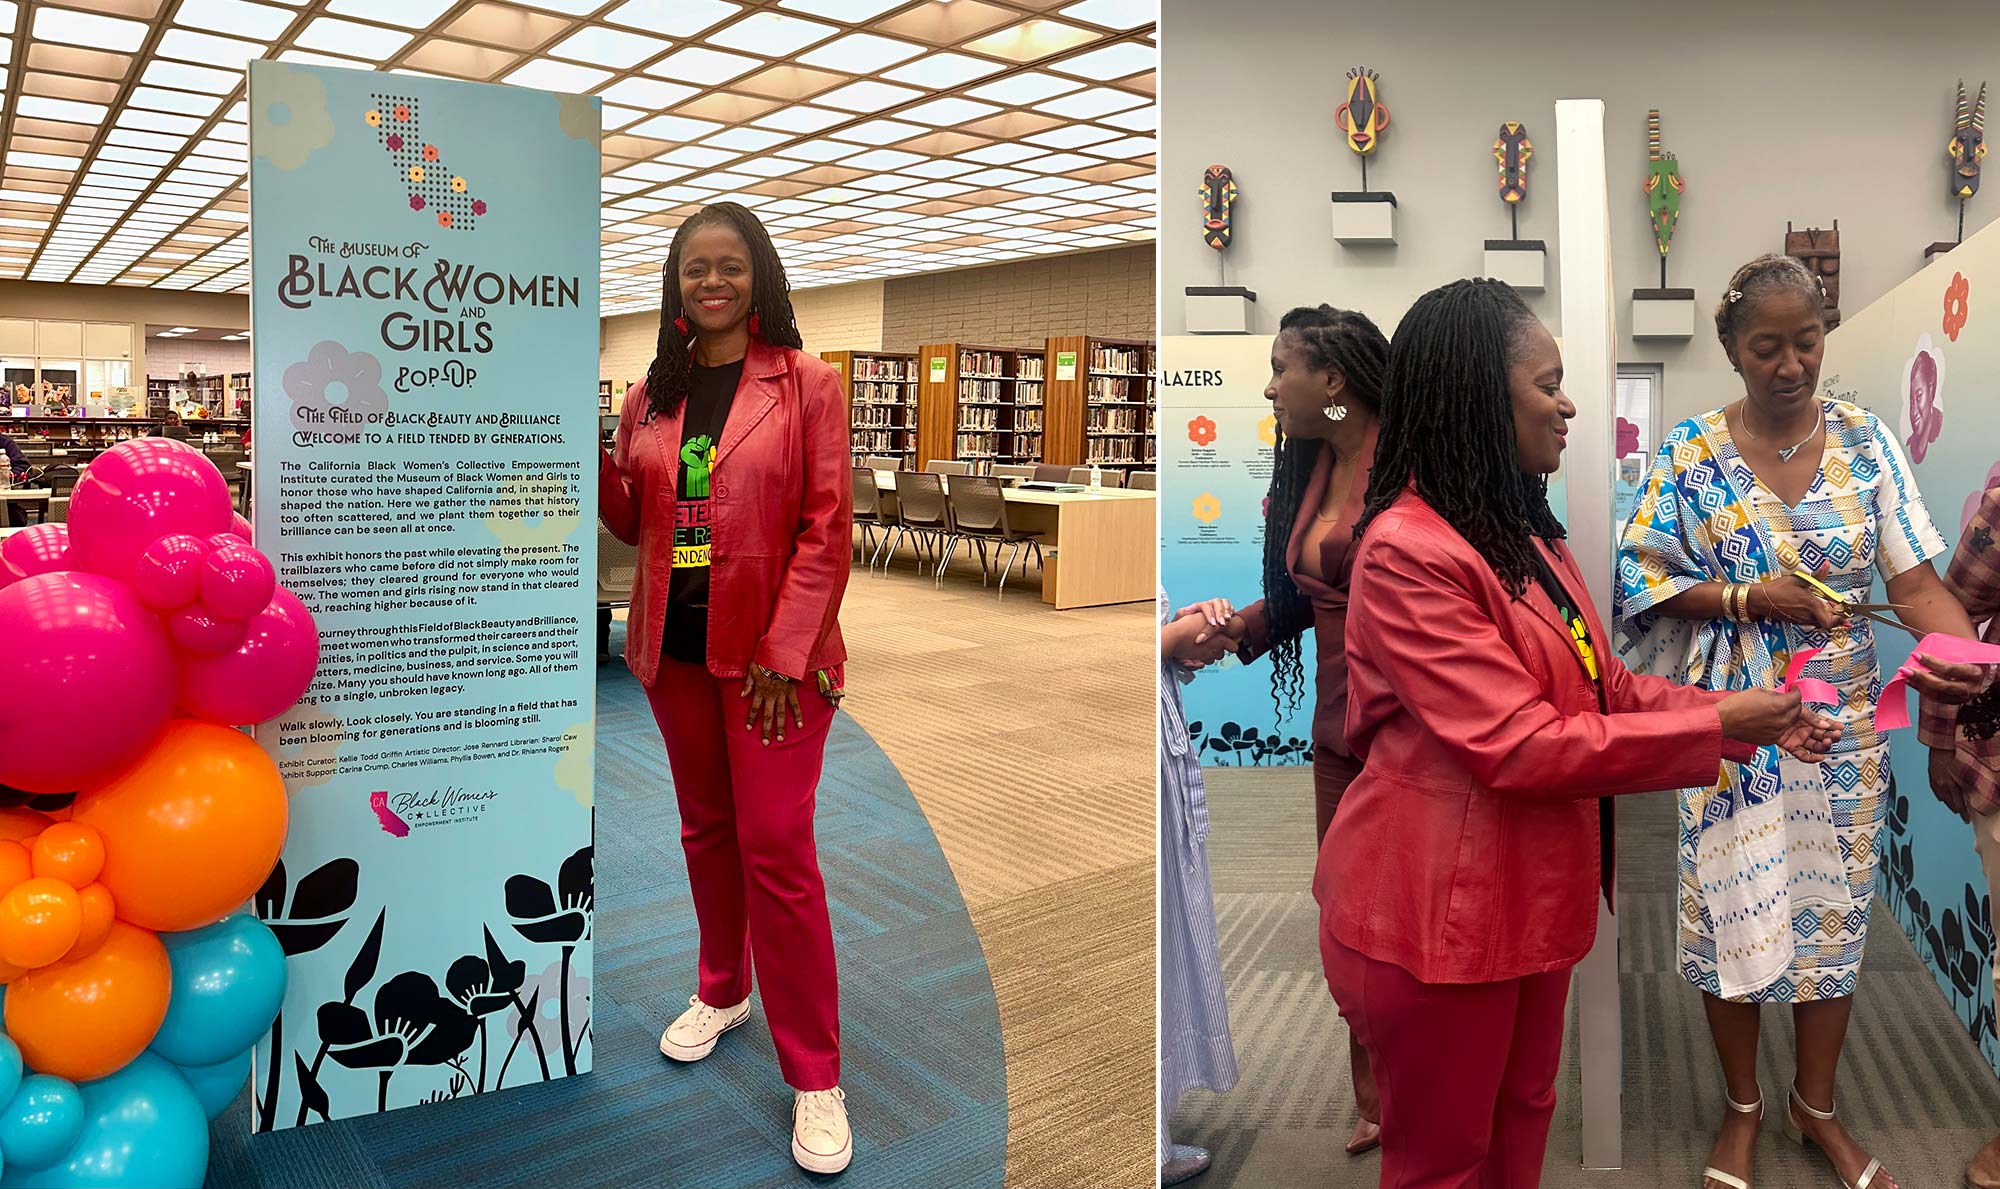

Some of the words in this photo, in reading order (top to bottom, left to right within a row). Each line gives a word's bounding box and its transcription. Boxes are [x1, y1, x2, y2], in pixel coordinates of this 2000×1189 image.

[340, 242, 398, 258] MUSEUM
[278, 254, 419, 309] BLACK
[423, 259, 579, 313] WOMEN
[460, 306, 486, 319] AND
[381, 311, 493, 353] GIRLS
[1161, 370, 1223, 387] LAZERS
[296, 405, 325, 425] THE
[329, 405, 363, 424] FIELD
[367, 412, 384, 425] OF
[385, 412, 426, 427] BLACK
[427, 412, 471, 427] BEAUTY
[475, 413, 498, 425] AND
[499, 413, 561, 428] BRILLIANCE
[293, 430, 361, 448] WELCOME
[365, 433, 381, 444] TO
[385, 433, 394, 444] A
[397, 433, 425, 445] FIELD
[429, 433, 471, 445] TENDED
[474, 433, 488, 445] BY
[490, 433, 565, 445] GENERATIONS.
[280, 461, 301, 471] The
[308, 461, 361, 471] California
[368, 461, 396, 470] Black
[403, 461, 450, 470] Women's
[456, 460, 505, 470] Collective
[511, 460, 580, 471] Empowerment
[280, 474, 328, 484] Institute
[330, 473, 373, 484] curated
[376, 473, 394, 483] the
[397, 473, 441, 483] Museum
[443, 473, 454, 482] of
[456, 472, 483, 482] Black
[486, 472, 523, 482] Women
[525, 472, 544, 481] and
[546, 472, 568, 481] Girls
[570, 473, 580, 481] to
[280, 488, 314, 497] honor
[316, 487, 348, 497] those
[351, 486, 374, 496] who
[376, 486, 402, 496] have
[405, 485, 443, 497] shaped
[445, 485, 493, 495] California
[496, 484, 517, 495] and,
[519, 484, 528, 493] in
[531, 484, 568, 495] shaping
[570, 483, 580, 493] it,
[281, 500, 322, 512] shaped
[325, 500, 344, 509] the
[347, 499, 384, 509] nation.
[387, 499, 412, 508] Here
[415, 500, 430, 508] we
[433, 498, 467, 510] gather
[469, 497, 486, 507] the
[489, 498, 522, 506] names
[524, 496, 544, 506] that
[547, 496, 580, 507] history
[281, 515, 300, 523] too
[303, 513, 333, 523] often
[337, 511, 392, 522] scattered,
[396, 511, 416, 521] and
[420, 512, 435, 520] we
[438, 510, 465, 522] plant
[468, 510, 495, 519] them
[498, 509, 540, 520] together
[558, 507, 580, 517] their
[280, 526, 332, 536] brilliance
[334, 527, 354, 535] can
[356, 525, 371, 534] be
[373, 526, 398, 534] seen
[400, 523, 412, 533] all
[414, 524, 425, 533] at
[427, 525, 455, 533] once.
[280, 552, 303, 562] This
[305, 551, 343, 562] exhibit
[345, 551, 382, 560] honors
[384, 550, 402, 559] the
[404, 549, 427, 560] past
[428, 548, 455, 557] while
[457, 546, 502, 557] elevating
[503, 546, 520, 555] the
[521, 545, 561, 556] present.
[562, 543, 579, 552] The
[280, 565, 342, 576] trailblazers
[344, 563, 367, 573] who
[369, 564, 399, 572] came
[402, 561, 436, 571] before
[438, 560, 455, 570] did
[457, 560, 474, 569] not
[476, 556, 509, 569] simply
[511, 557, 537, 566] make
[539, 557, 564, 565] room
[566, 555, 579, 564] for
[280, 721, 306, 732] Walk
[309, 718, 345, 730] slowly.
[346, 715, 372, 726] Look
[374, 712, 413, 724] closely.
[415, 711, 434, 720] You
[435, 710, 452, 719] are
[454, 705, 497, 717] standing
[498, 704, 508, 713] in
[517, 701, 538, 711] field
[540, 700, 559, 709] that
[561, 699, 578, 707] has
[279, 736, 307, 746] been
[310, 731, 360, 743] blooming
[362, 729, 378, 738] for
[379, 724, 441, 739] generations
[443, 720, 462, 731] and
[464, 720, 473, 729] is
[475, 716, 520, 728] blooming
[522, 714, 541, 724] still.
[373, 797, 385, 807] CA
[391, 790, 440, 814] Black
[415, 819, 452, 828] EMPOWERMENT
[454, 816, 478, 824] INSTITUTE
